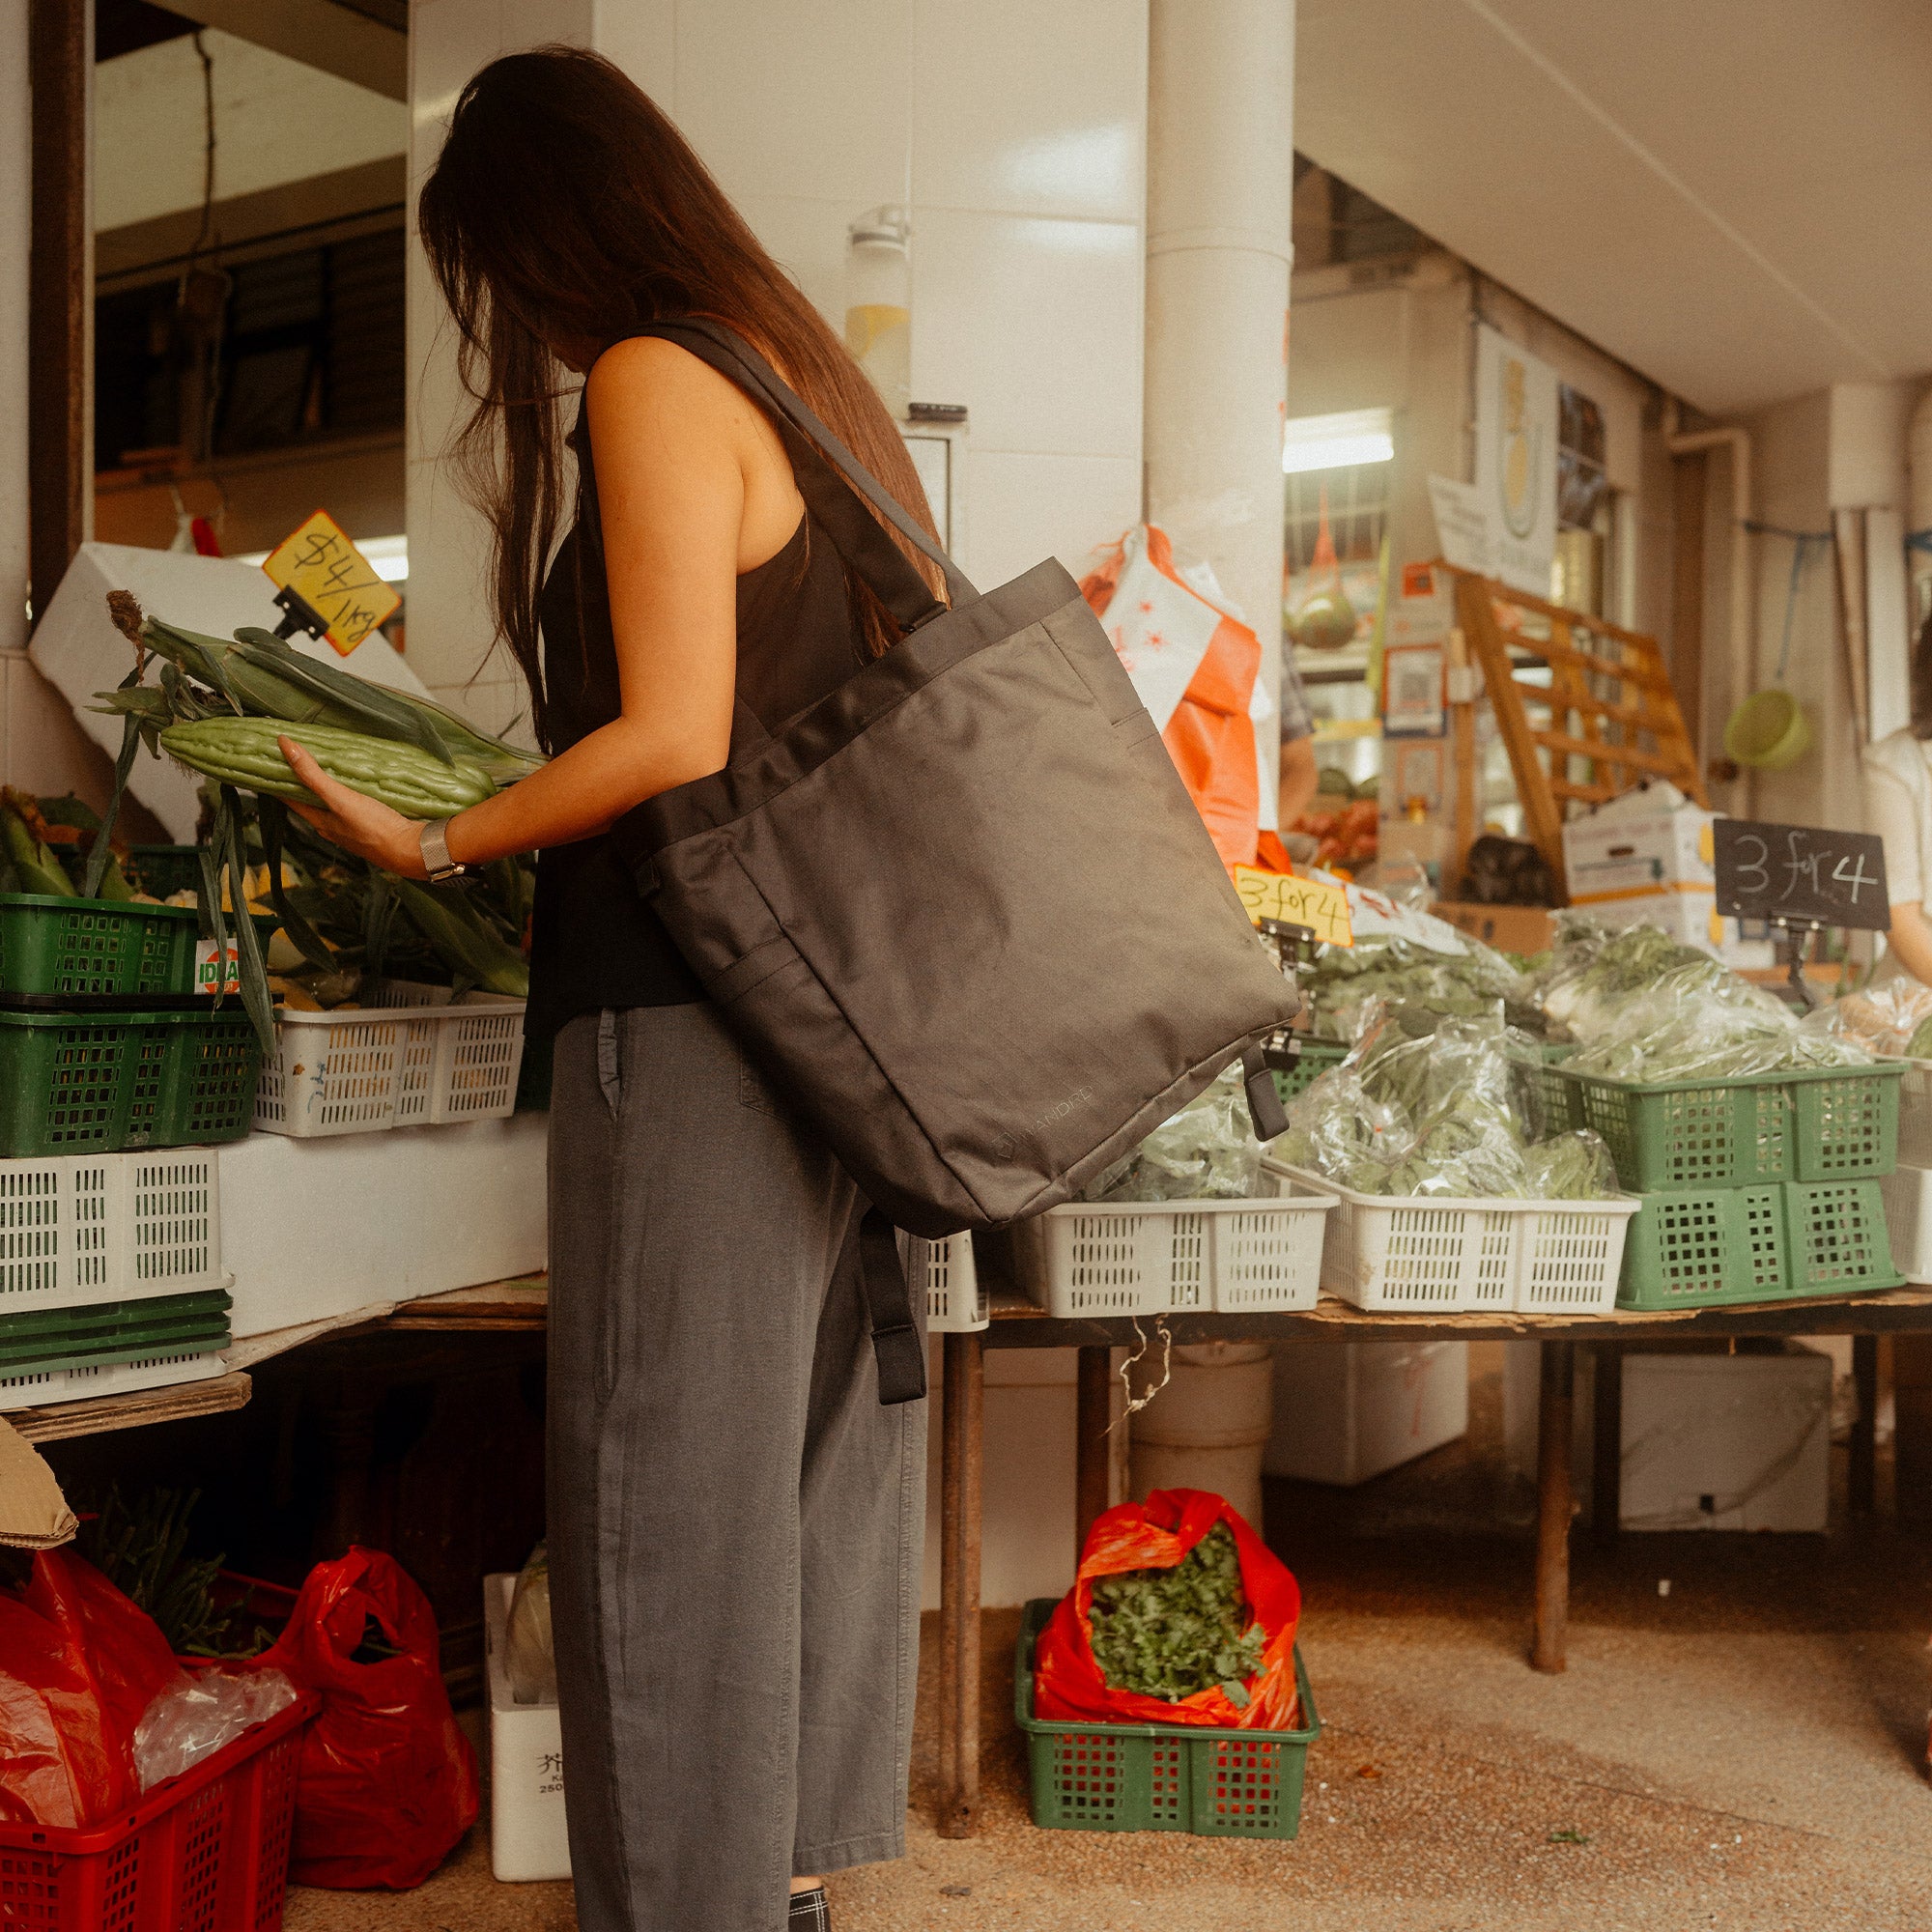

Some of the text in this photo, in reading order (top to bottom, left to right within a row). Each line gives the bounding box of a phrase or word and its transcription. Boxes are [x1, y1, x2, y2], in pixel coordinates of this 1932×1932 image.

[1734, 835, 1770, 893] 3
[1832, 853, 1879, 904] 4
[1240, 877, 1268, 908] 3
[1270, 879, 1316, 921] for
[1318, 893, 1349, 937] 4
